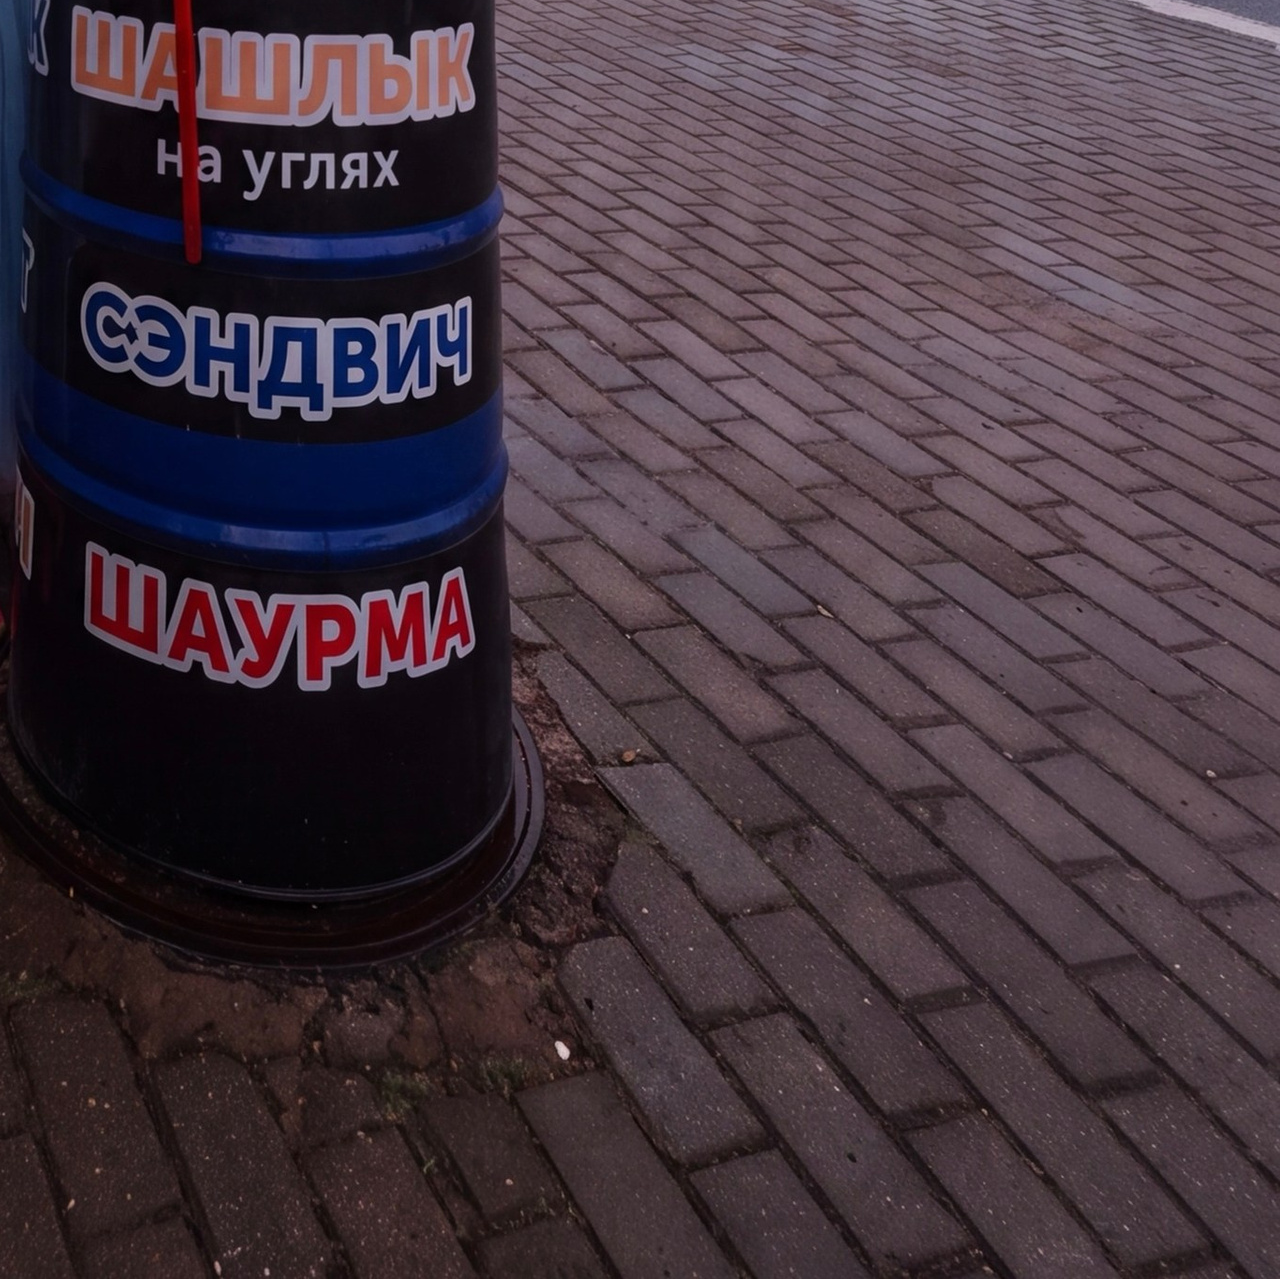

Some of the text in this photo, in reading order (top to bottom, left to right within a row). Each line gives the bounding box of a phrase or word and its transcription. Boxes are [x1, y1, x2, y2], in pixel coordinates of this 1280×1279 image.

[71, 5, 476, 127] ШАШЛЫК
[156, 138, 400, 202] на углях
[81, 282, 472, 421] СЭНДВИЧ
[84, 541, 476, 691] ШАУРМА
